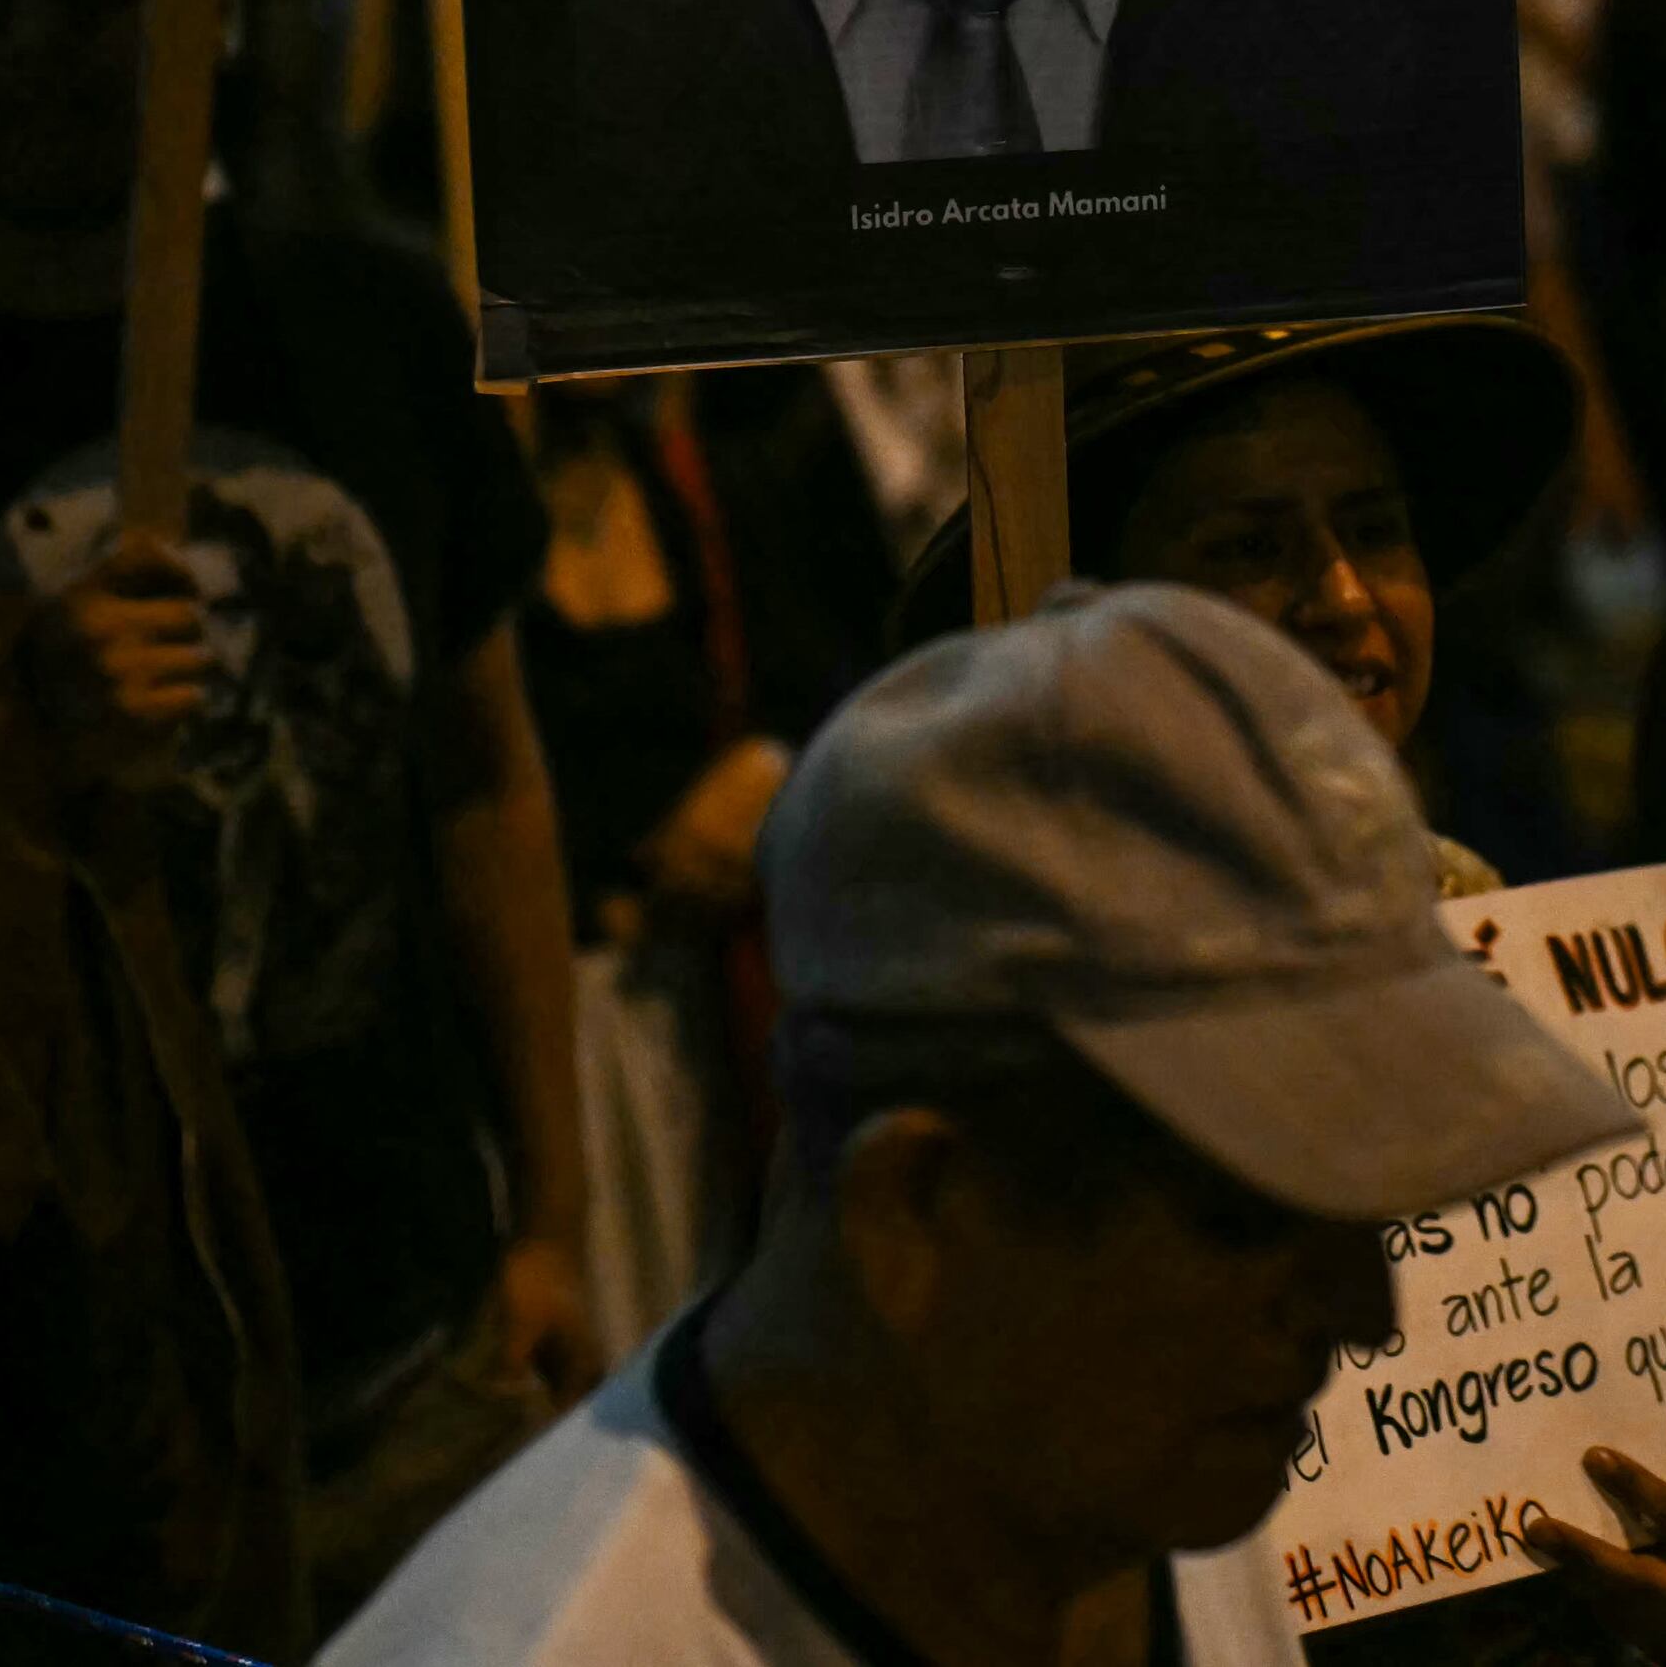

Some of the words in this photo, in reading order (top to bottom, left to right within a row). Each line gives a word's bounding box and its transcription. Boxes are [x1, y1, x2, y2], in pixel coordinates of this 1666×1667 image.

[851, 201, 934, 230] Isidro
[941, 197, 1040, 225] Arcata
[1047, 184, 1168, 218] Mamani
[1383, 1211, 1453, 1262] as
[1471, 1183, 1536, 1241] no
[1442, 1257, 1560, 1336] ante
[1585, 1234, 1643, 1301] la
[1284, 1409, 1329, 1492] el
[1366, 1341, 1598, 1455] Kongreso
